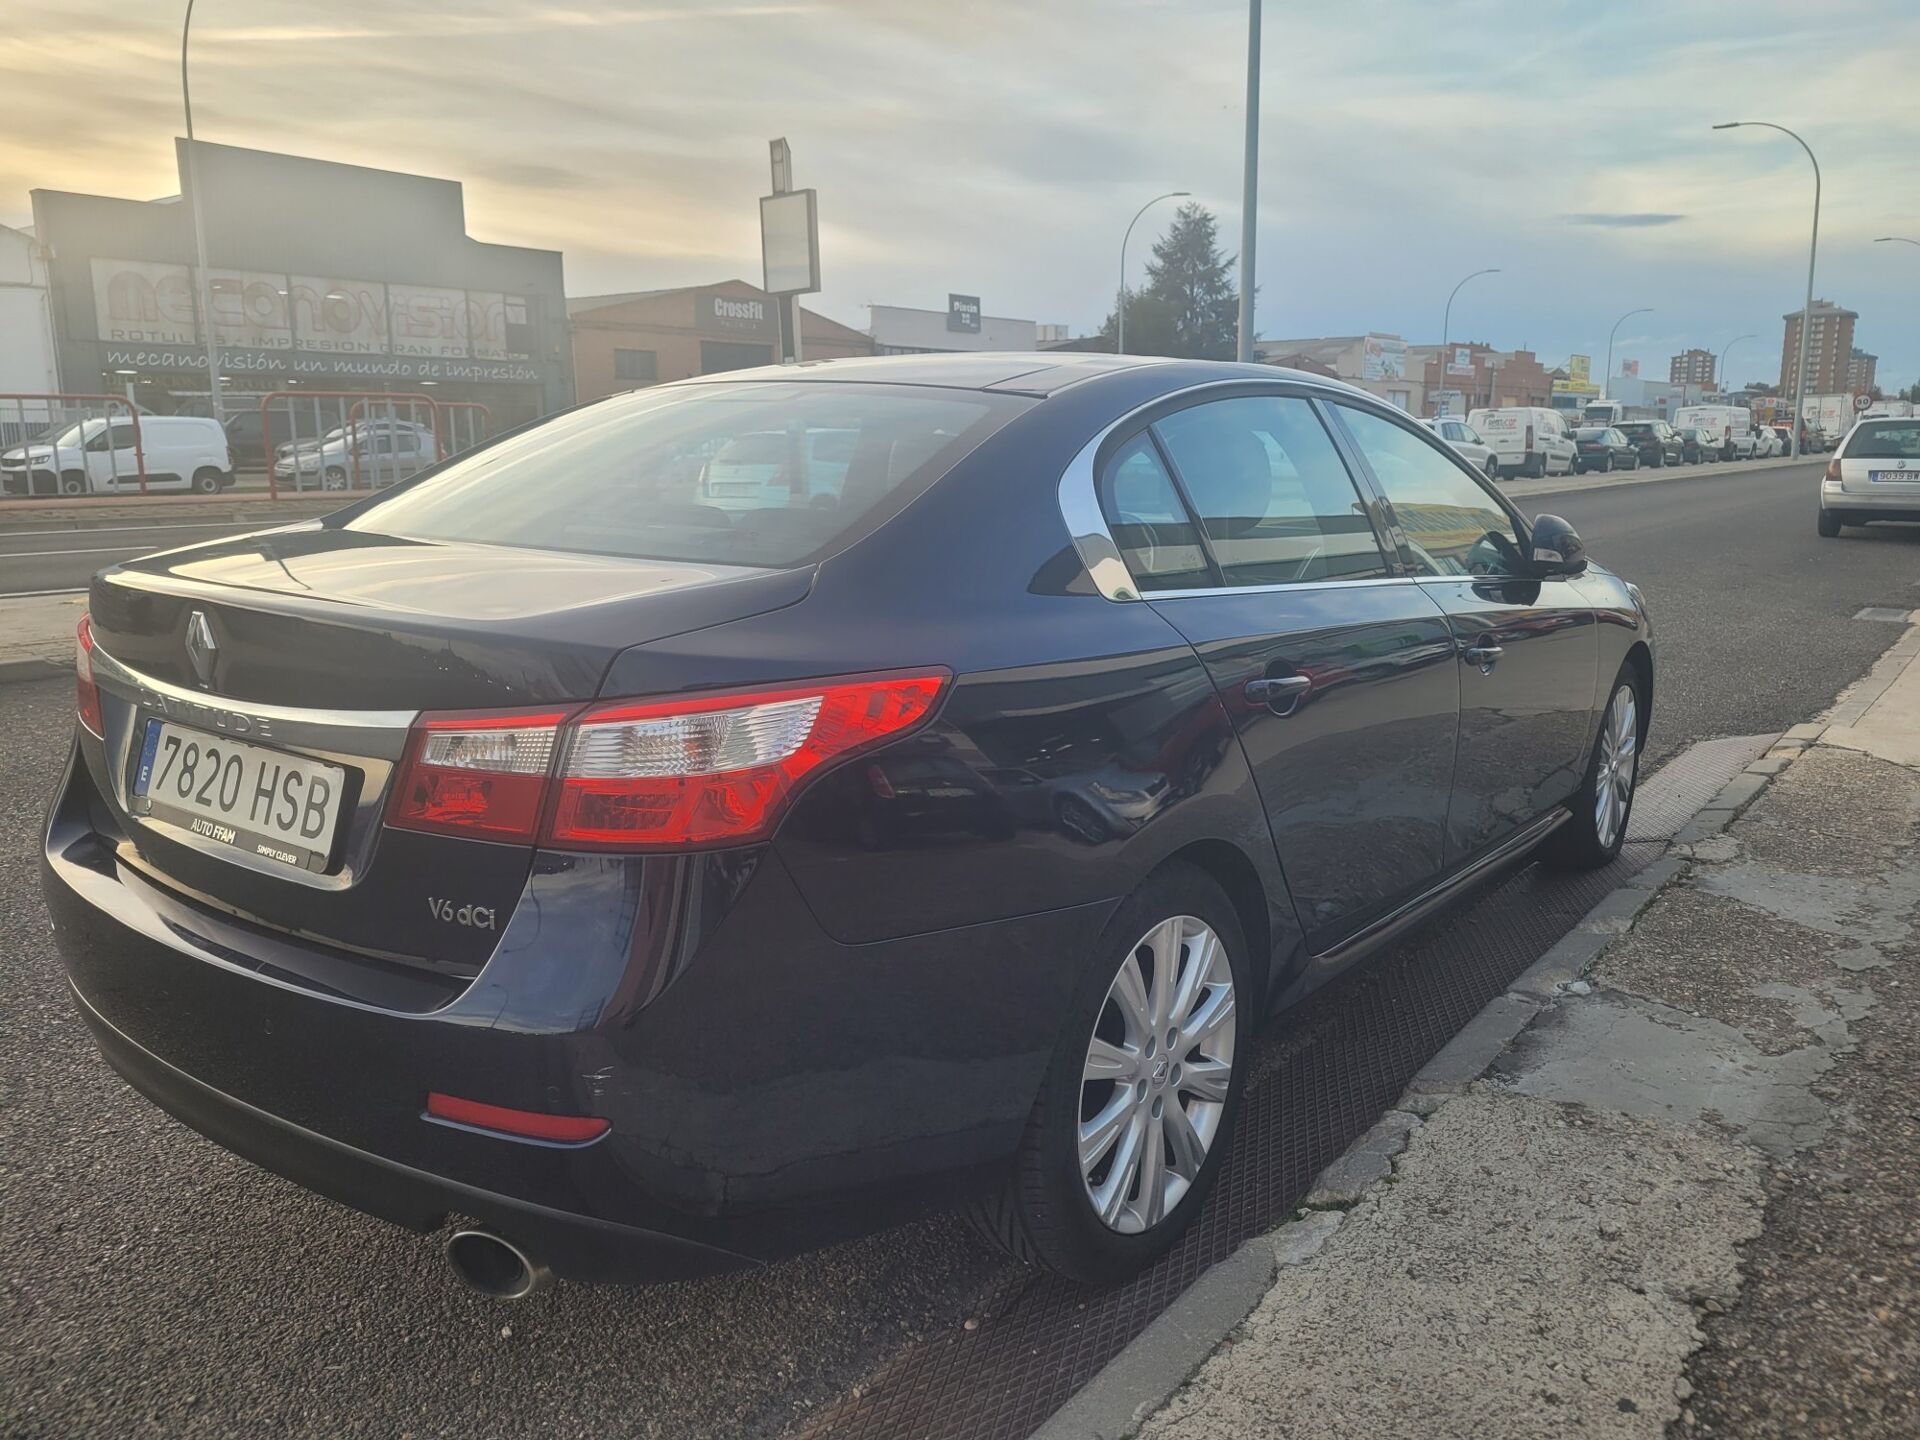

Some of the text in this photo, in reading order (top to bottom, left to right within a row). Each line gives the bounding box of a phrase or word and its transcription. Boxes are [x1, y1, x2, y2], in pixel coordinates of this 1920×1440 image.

[714, 297, 763, 320] CrossFit
[251, 337, 371, 352] IMPRESION
[294, 359, 328, 373] un
[334, 359, 412, 377] mundo
[418, 360, 439, 378] de
[445, 360, 538, 382] impresión
[1879, 471, 1905, 480] 9039
[141, 735, 331, 840] E 7820 HSB
[191, 818, 236, 844] AUTO FFAM
[256, 844, 298, 865] SIMPLY CLEVER
[428, 897, 496, 930] V6 dCi
